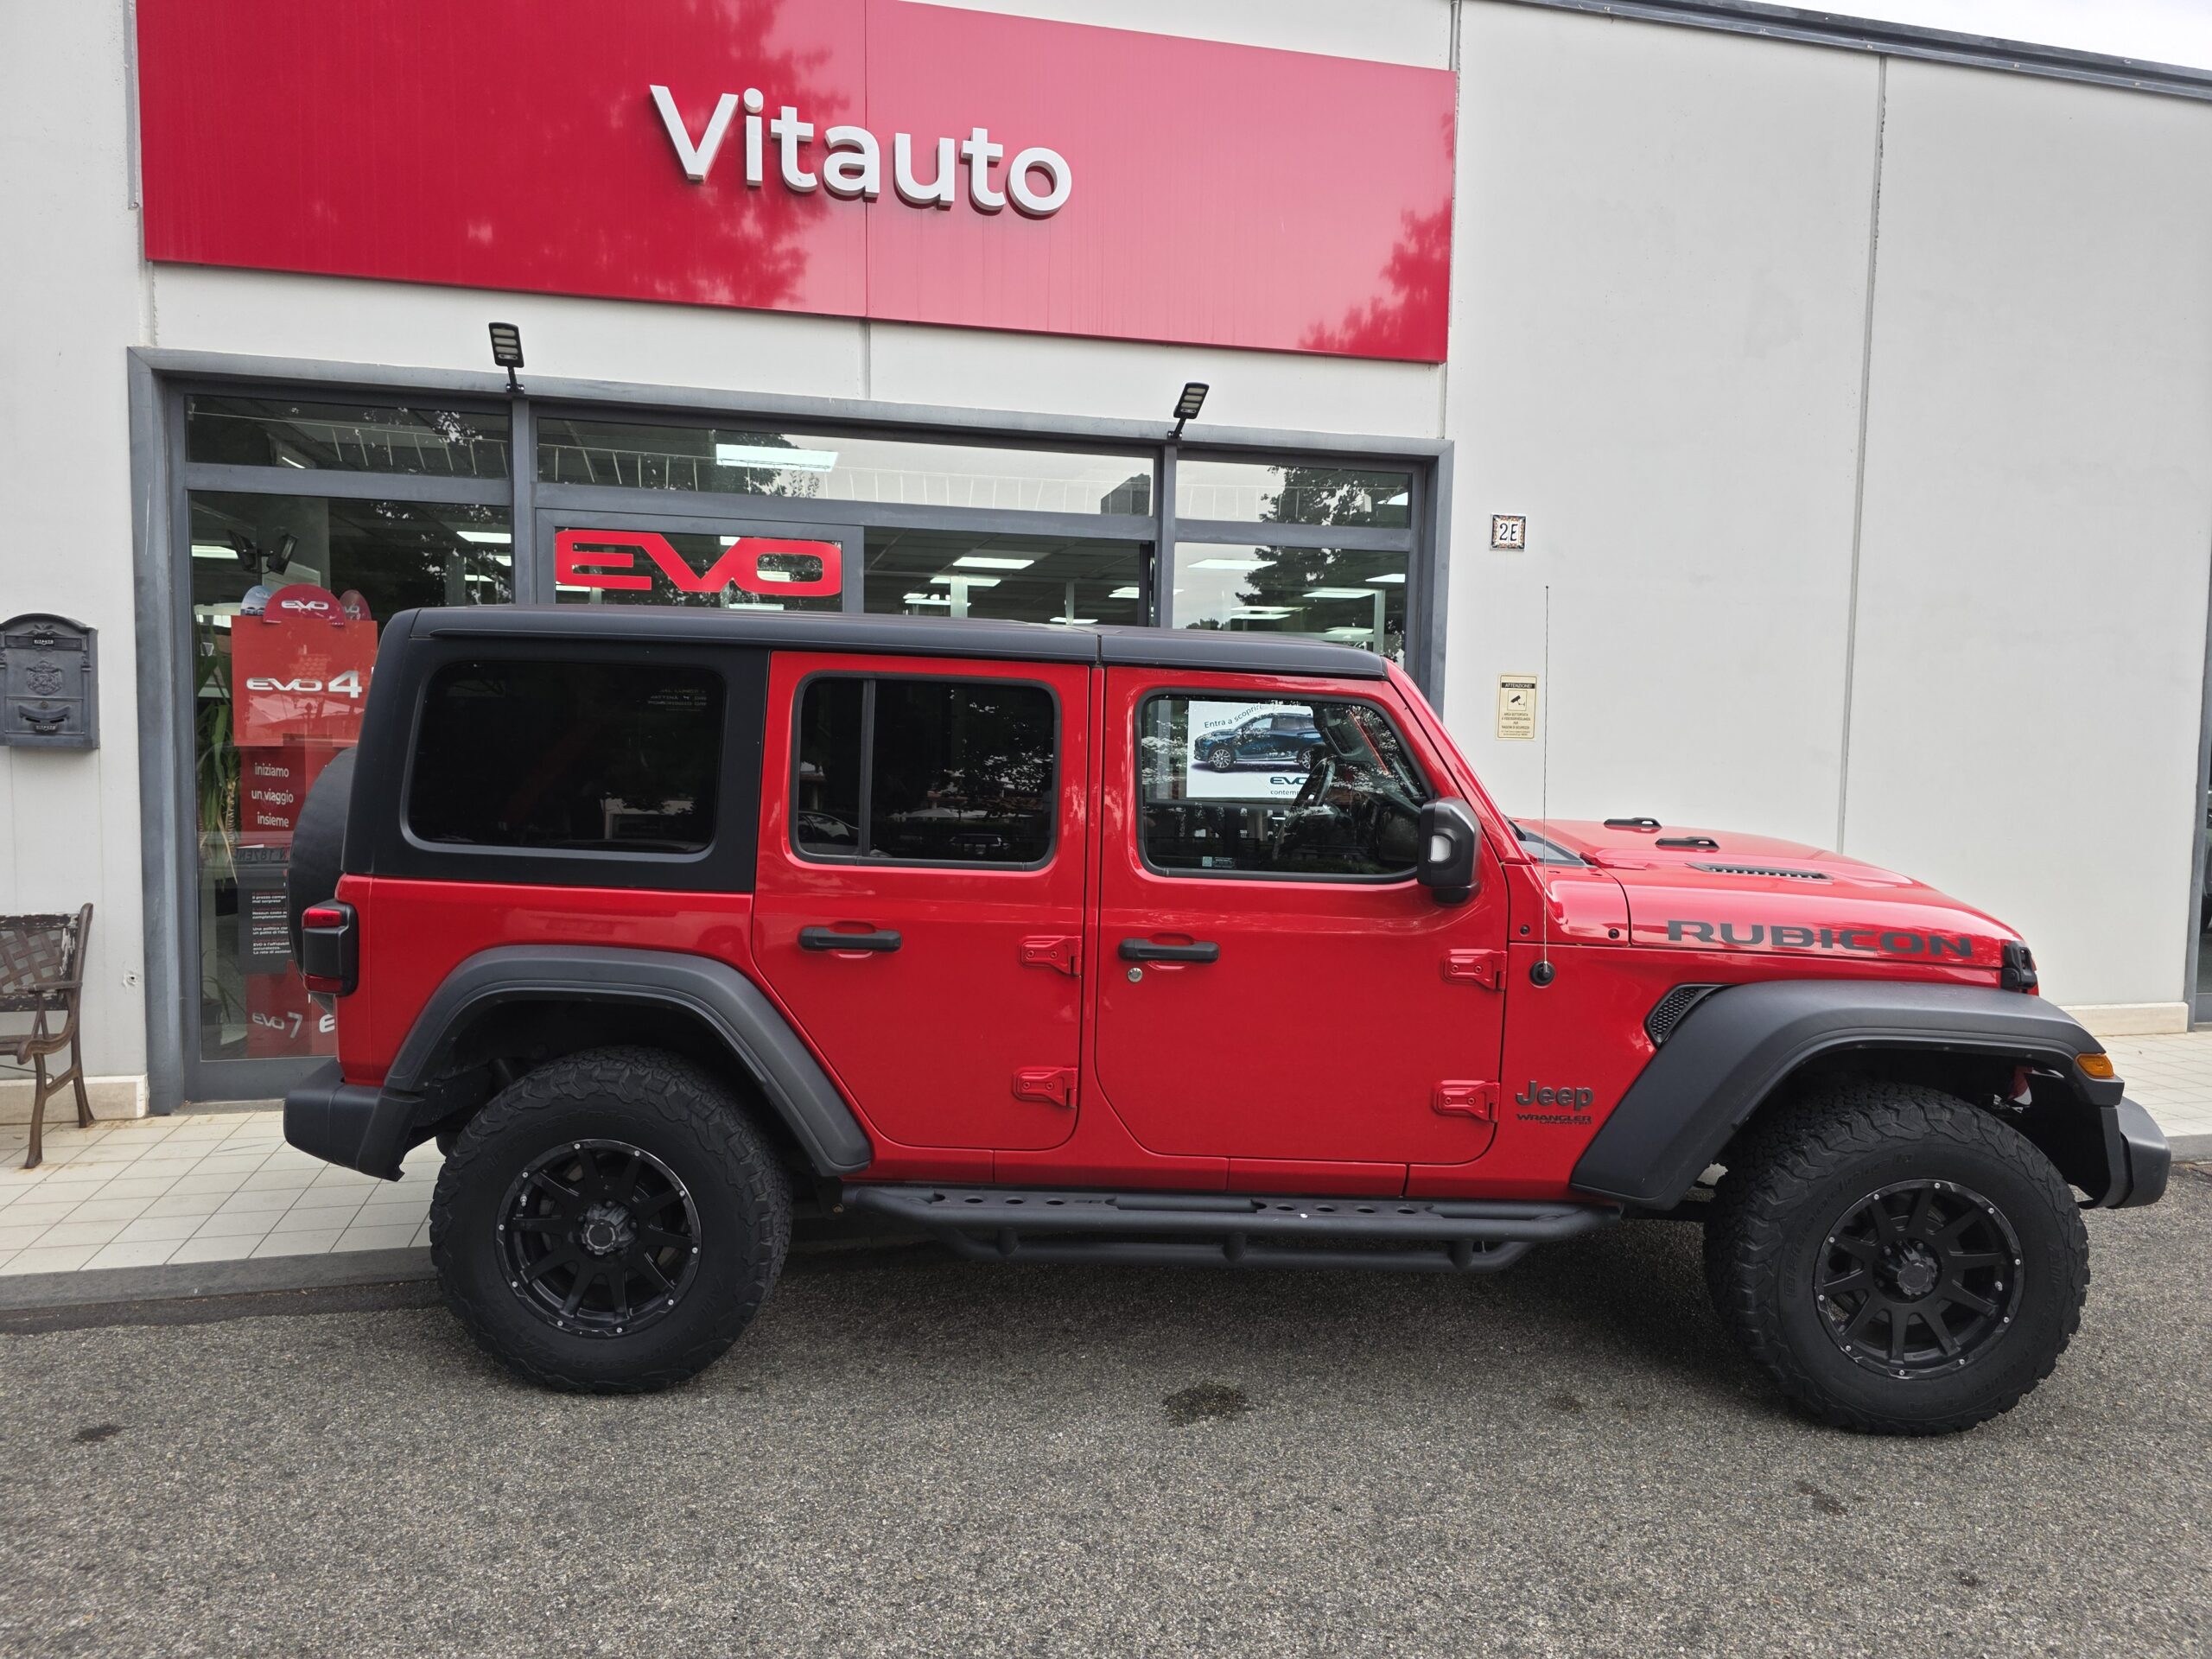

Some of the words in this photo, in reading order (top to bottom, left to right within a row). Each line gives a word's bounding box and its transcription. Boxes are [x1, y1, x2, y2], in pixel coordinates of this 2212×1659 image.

[650, 84, 1071, 216] Vitauto
[1500, 523, 1518, 542] 2E
[555, 529, 842, 596] EVO
[281, 600, 329, 610] EVO
[1204, 720, 1226, 728] Entra
[254, 762, 289, 778] iniziamo
[251, 790, 262, 800] un
[264, 788, 294, 805] viaggio
[257, 811, 289, 828] insieme
[1667, 919, 1974, 957] RUBICON
[1516, 1080, 1593, 1110] Jeep
[1516, 1113, 1592, 1122] WRANGLER
